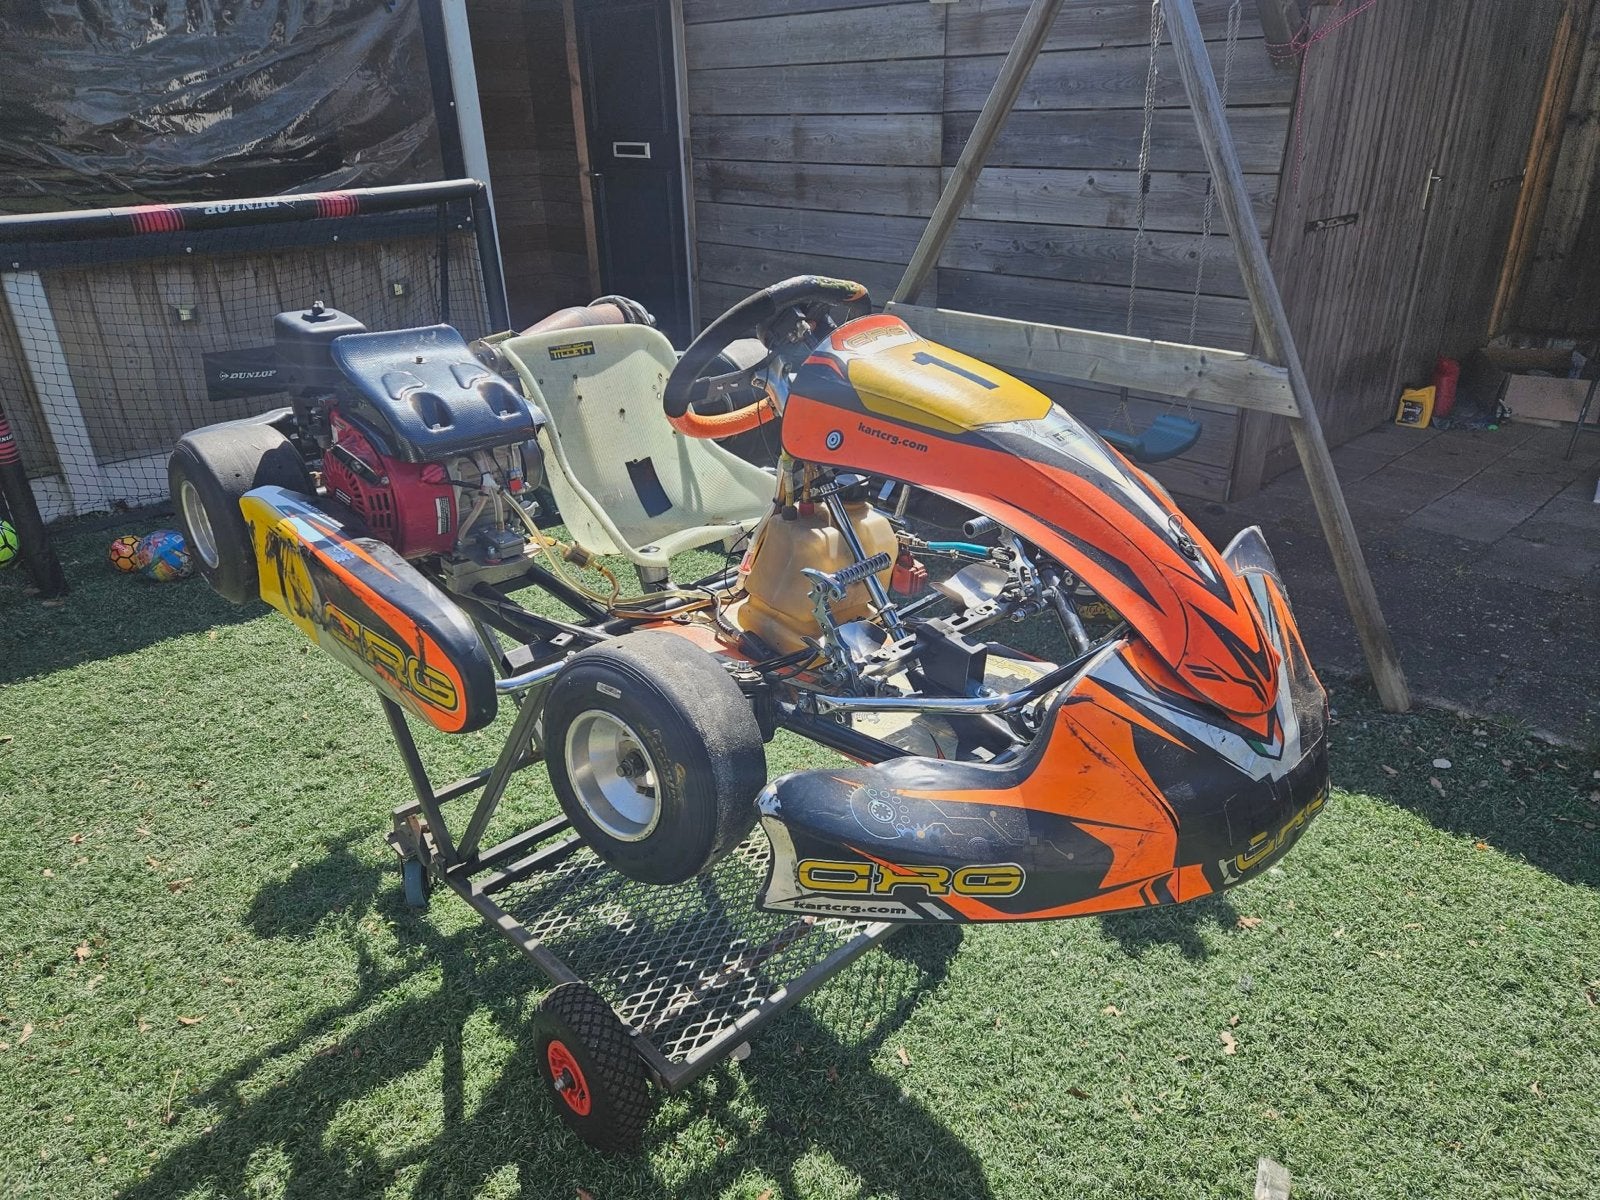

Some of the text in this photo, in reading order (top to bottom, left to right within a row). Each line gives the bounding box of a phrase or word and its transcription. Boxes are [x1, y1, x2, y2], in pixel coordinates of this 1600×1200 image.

[846, 325, 907, 348] CRG
[229, 370, 277, 379] DUNLOP
[912, 351, 1000, 390] 1
[858, 422, 929, 453] kartcrg.com
[324, 602, 460, 712] CRG
[797, 859, 1026, 897] CRG
[793, 900, 907, 915] kartcrg.com
